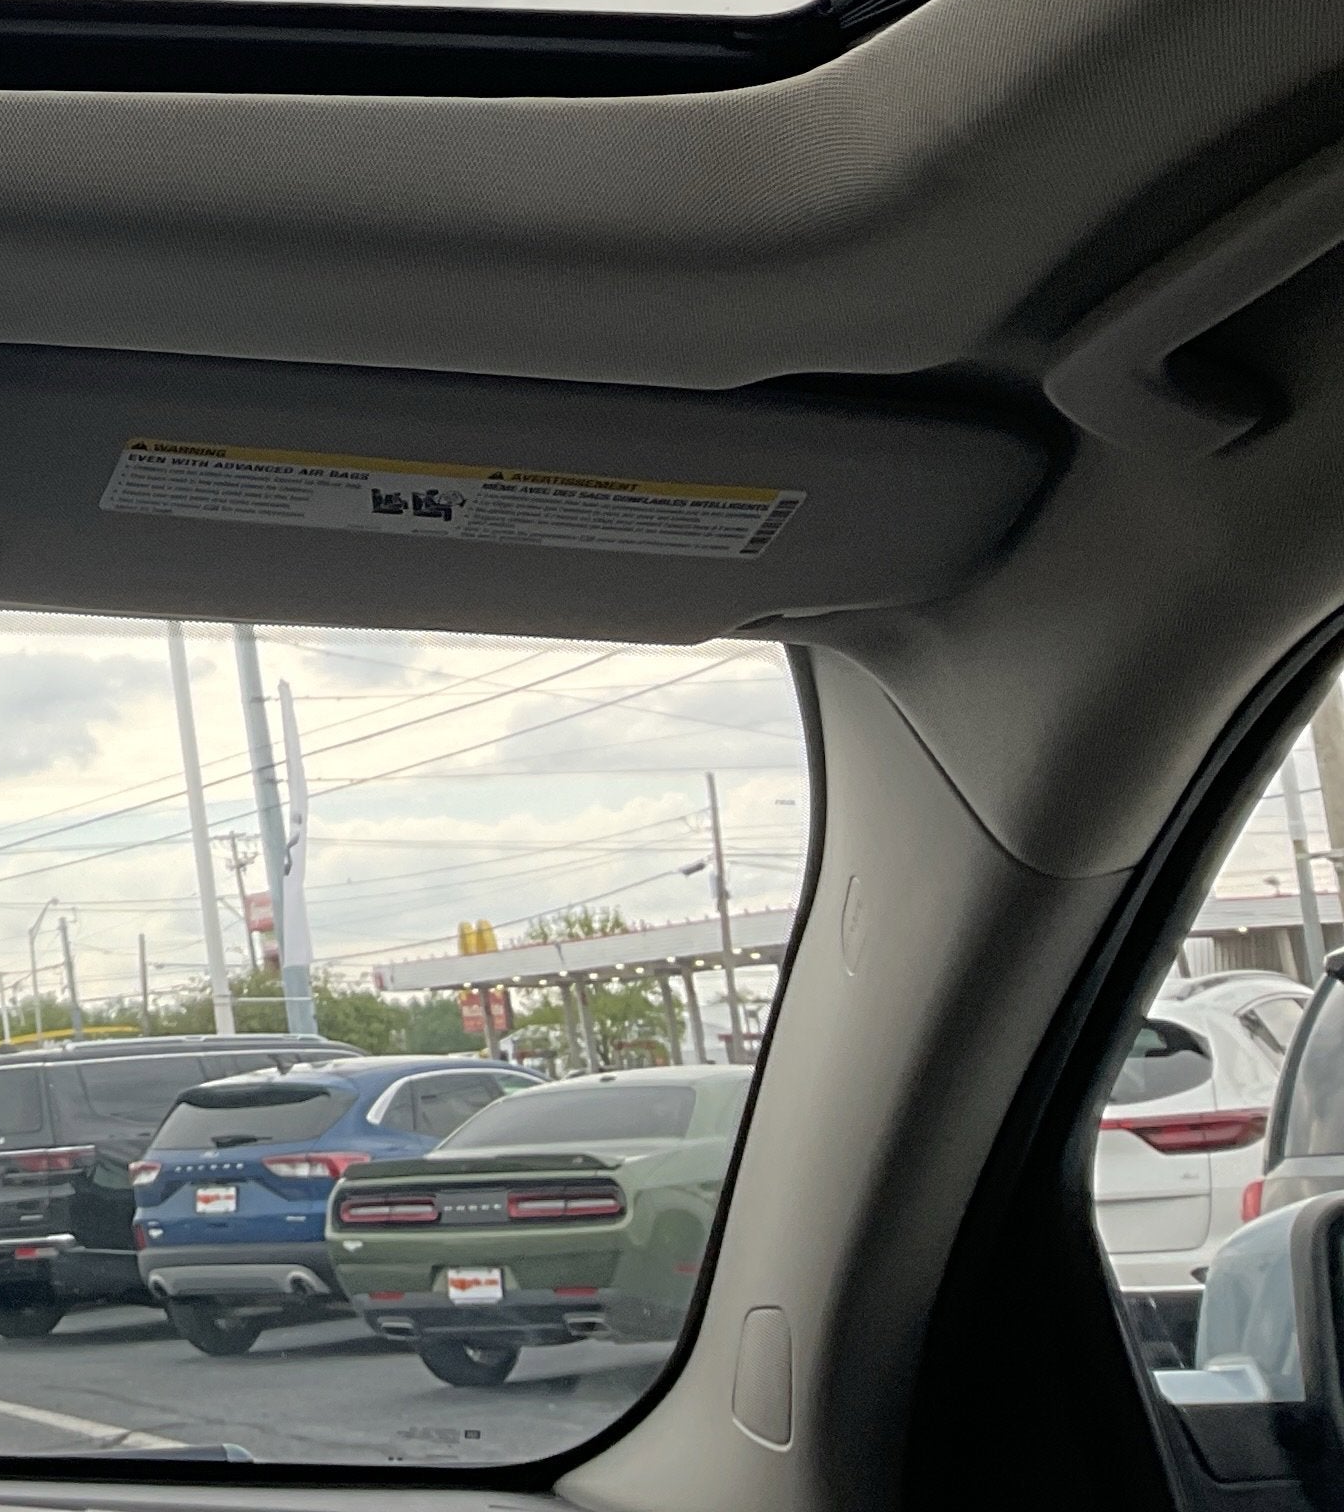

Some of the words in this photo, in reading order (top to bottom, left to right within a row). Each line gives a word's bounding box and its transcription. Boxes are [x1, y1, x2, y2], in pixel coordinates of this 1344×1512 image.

[153, 444, 227, 459] WARNING
[127, 453, 166, 464] EVEN
[171, 457, 209, 468] WITH
[213, 461, 294, 475] ADVANCED
[298, 468, 324, 478] AIR
[329, 470, 370, 481] BAGS
